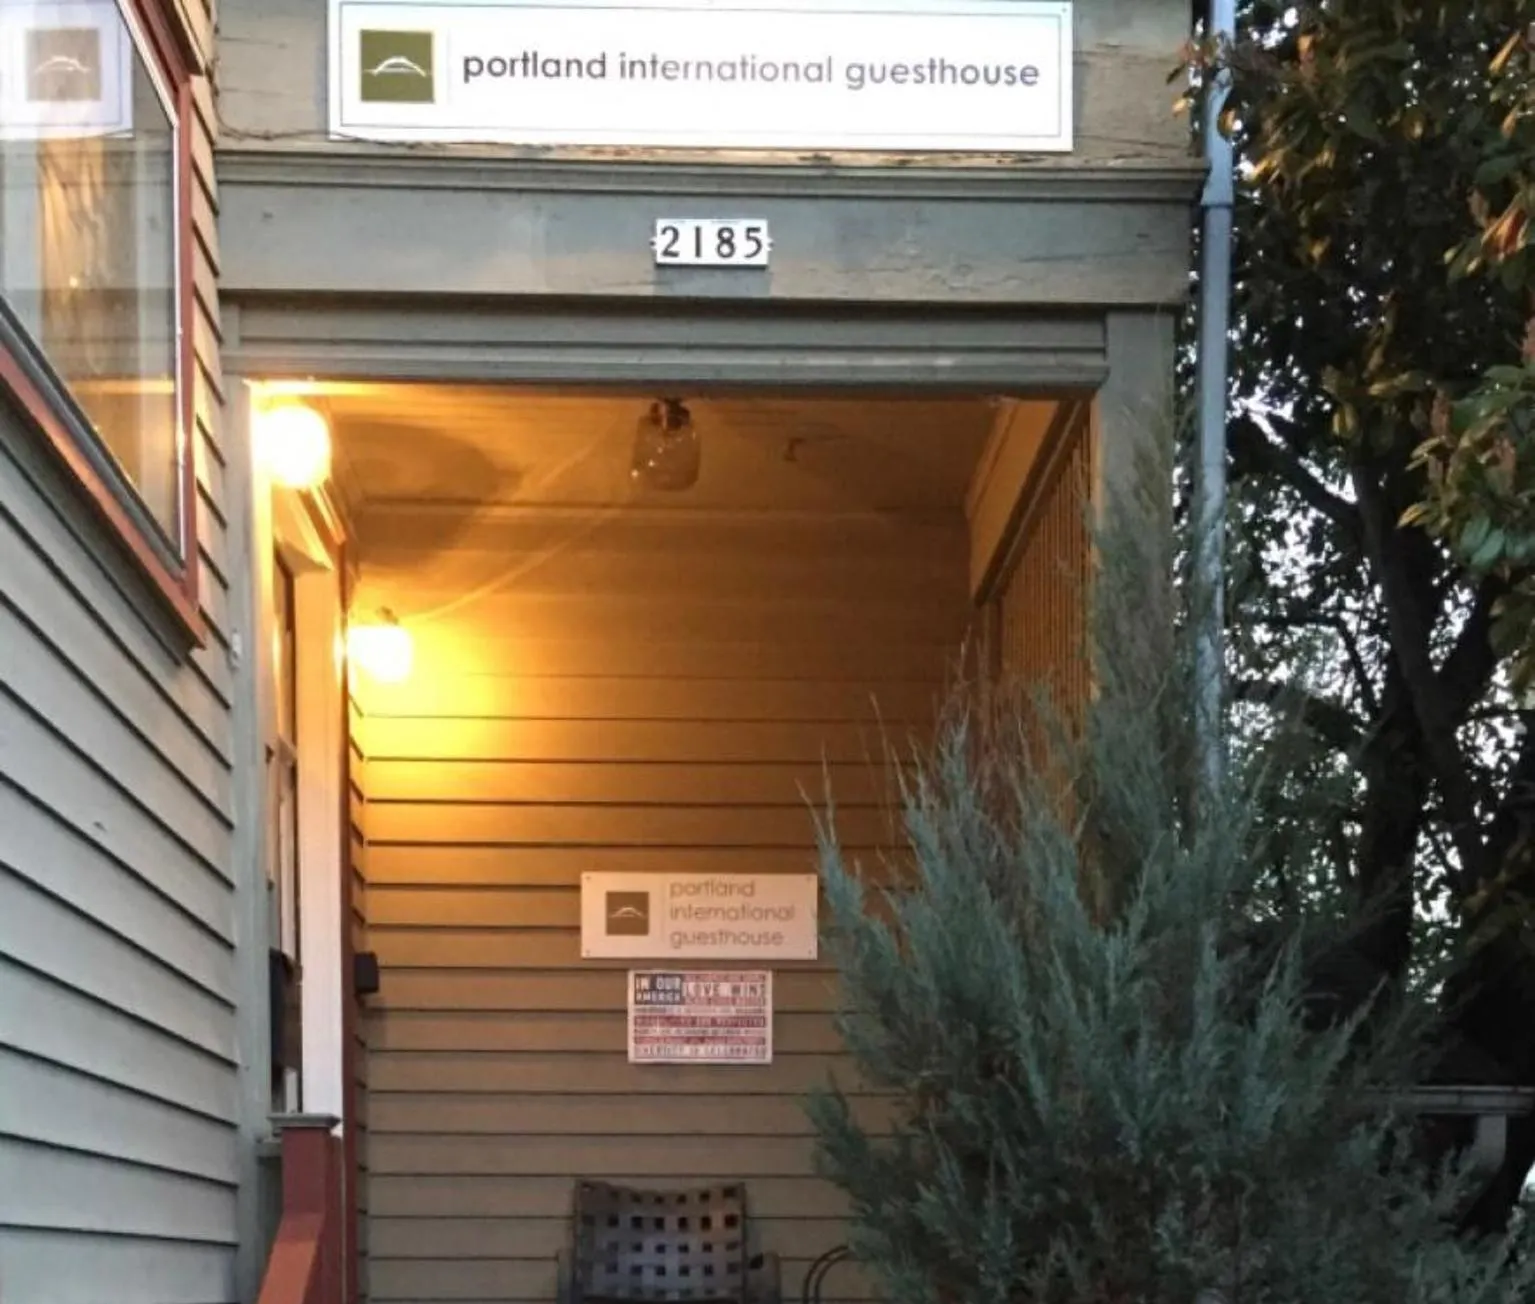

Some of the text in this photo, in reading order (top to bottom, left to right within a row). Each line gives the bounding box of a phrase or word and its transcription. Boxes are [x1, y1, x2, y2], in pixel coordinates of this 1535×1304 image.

[462, 50, 1041, 91] portland international guesthouse
[660, 225, 763, 259] 2185
[669, 879, 756, 898] portland
[669, 903, 796, 922] international
[669, 927, 786, 949] guesthouse
